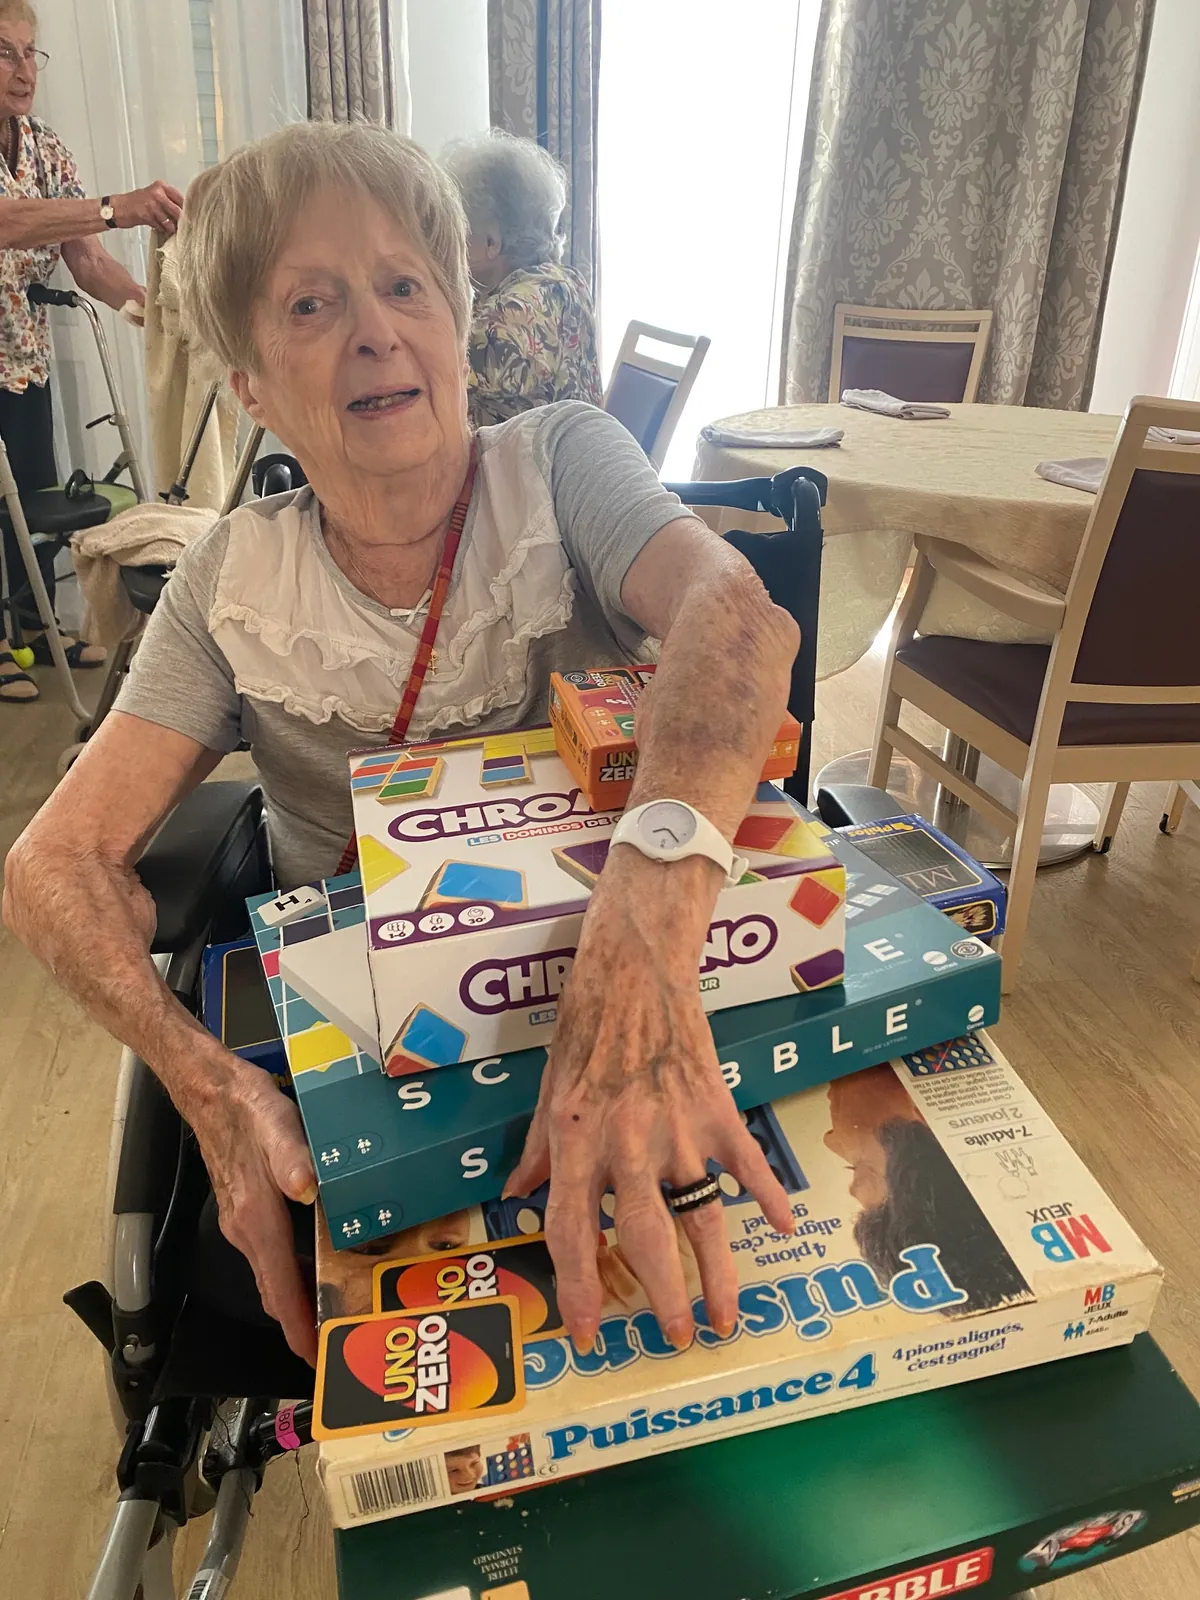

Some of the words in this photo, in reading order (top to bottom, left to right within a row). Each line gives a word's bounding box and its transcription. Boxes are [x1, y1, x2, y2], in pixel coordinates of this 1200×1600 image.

[607, 751, 637, 767] UN
[600, 766, 636, 783] ZER
[392, 790, 594, 841] CHRO
[468, 833, 502, 847] LES
[503, 822, 584, 841] DOMINOS
[584, 817, 611, 829] DE
[529, 1009, 557, 1025] LES
[949, 1107, 1011, 1129] joueurs
[1009, 1107, 1023, 1119] 2
[965, 1124, 1033, 1146] 7-Adulte
[742, 1203, 809, 1234] gané!
[1025, 1202, 1073, 1223] JEUX
[730, 1234, 764, 1253] c'es
[812, 1242, 827, 1258] 4
[1030, 1213, 1113, 1263] MB
[755, 1241, 812, 1267] pions
[436, 1265, 467, 1306] NO
[466, 1254, 497, 1300] RO
[1084, 1283, 1116, 1307] MB
[1084, 1301, 1113, 1314] JEUX
[1088, 1310, 1129, 1325] 7-Adulte
[892, 1347, 904, 1361] 4
[905, 1339, 955, 1359] pions
[956, 1322, 1025, 1346] alignés,
[384, 1325, 417, 1402] UNO
[415, 1315, 449, 1413] ZERO
[907, 1353, 946, 1373] c'est
[946, 1337, 1007, 1365] gagné!
[546, 1371, 834, 1461] Puissance
[838, 1352, 878, 1391] 4
[473, 1545, 523, 1565] STANDARD
